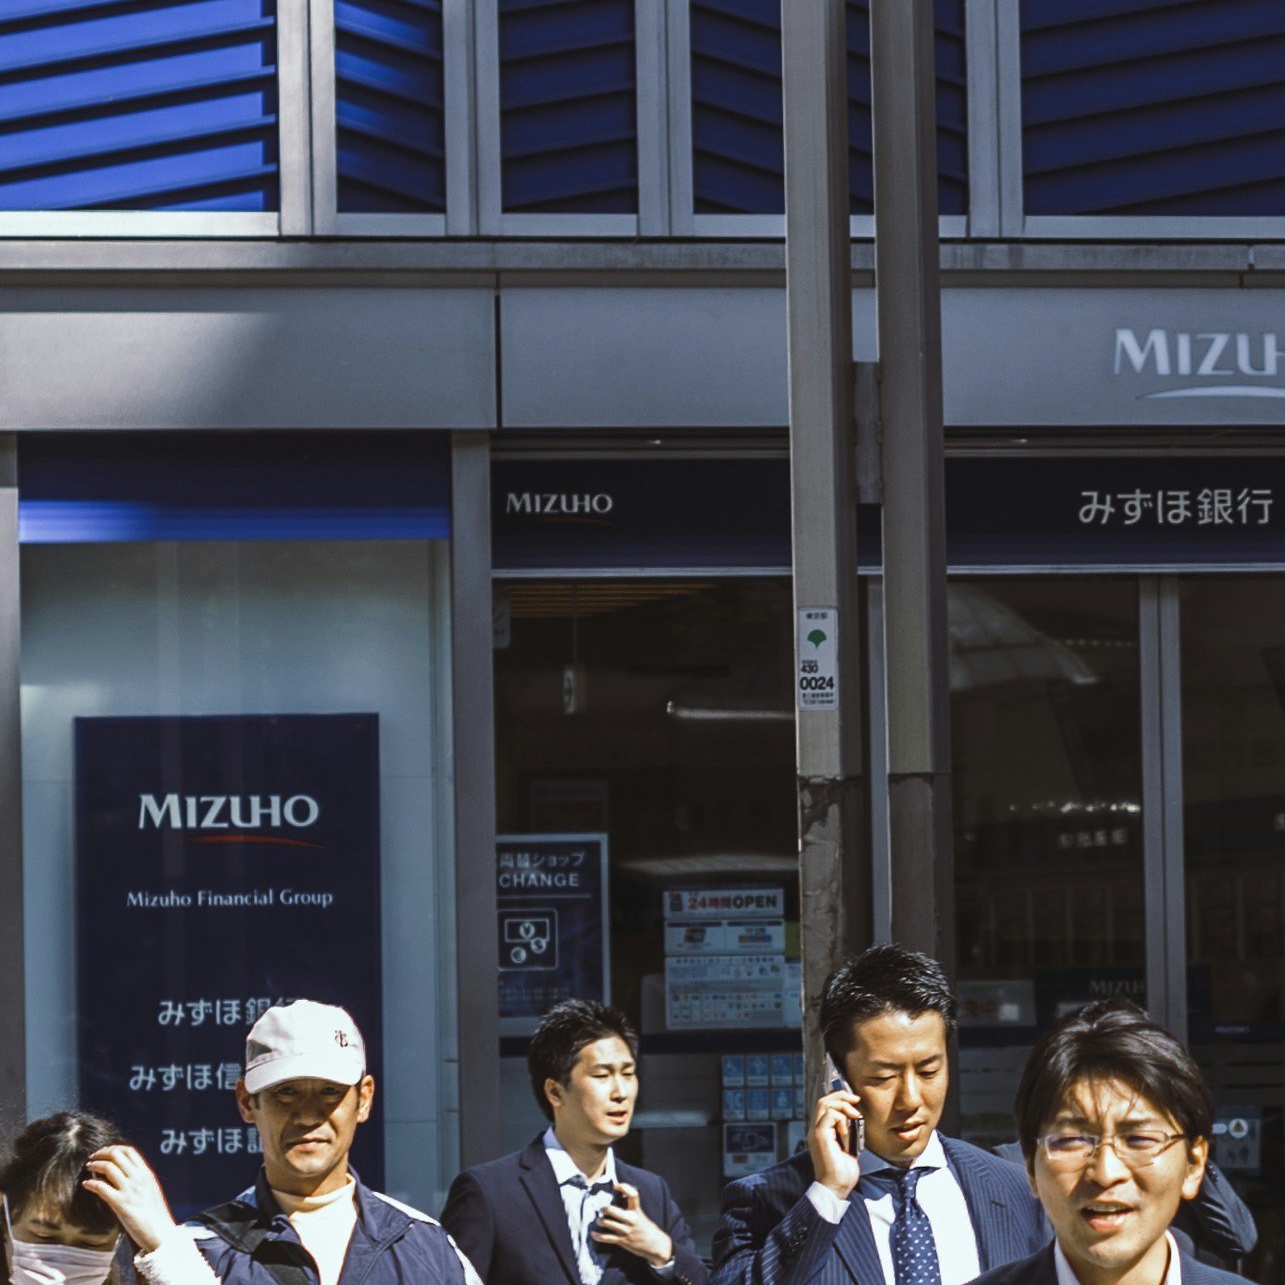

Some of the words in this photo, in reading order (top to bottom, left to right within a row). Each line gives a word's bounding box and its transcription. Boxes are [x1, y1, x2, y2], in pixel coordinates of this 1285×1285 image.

[506, 492, 613, 513] MIZUHO
[1078, 487, 1274, 525] みずほ銀行
[800, 664, 819, 674] 430
[799, 676, 835, 691] 0024
[137, 793, 320, 830] MIZUHO
[126, 891, 192, 908] Mizuho
[197, 889, 274, 907] Financial
[279, 889, 334, 909] Group
